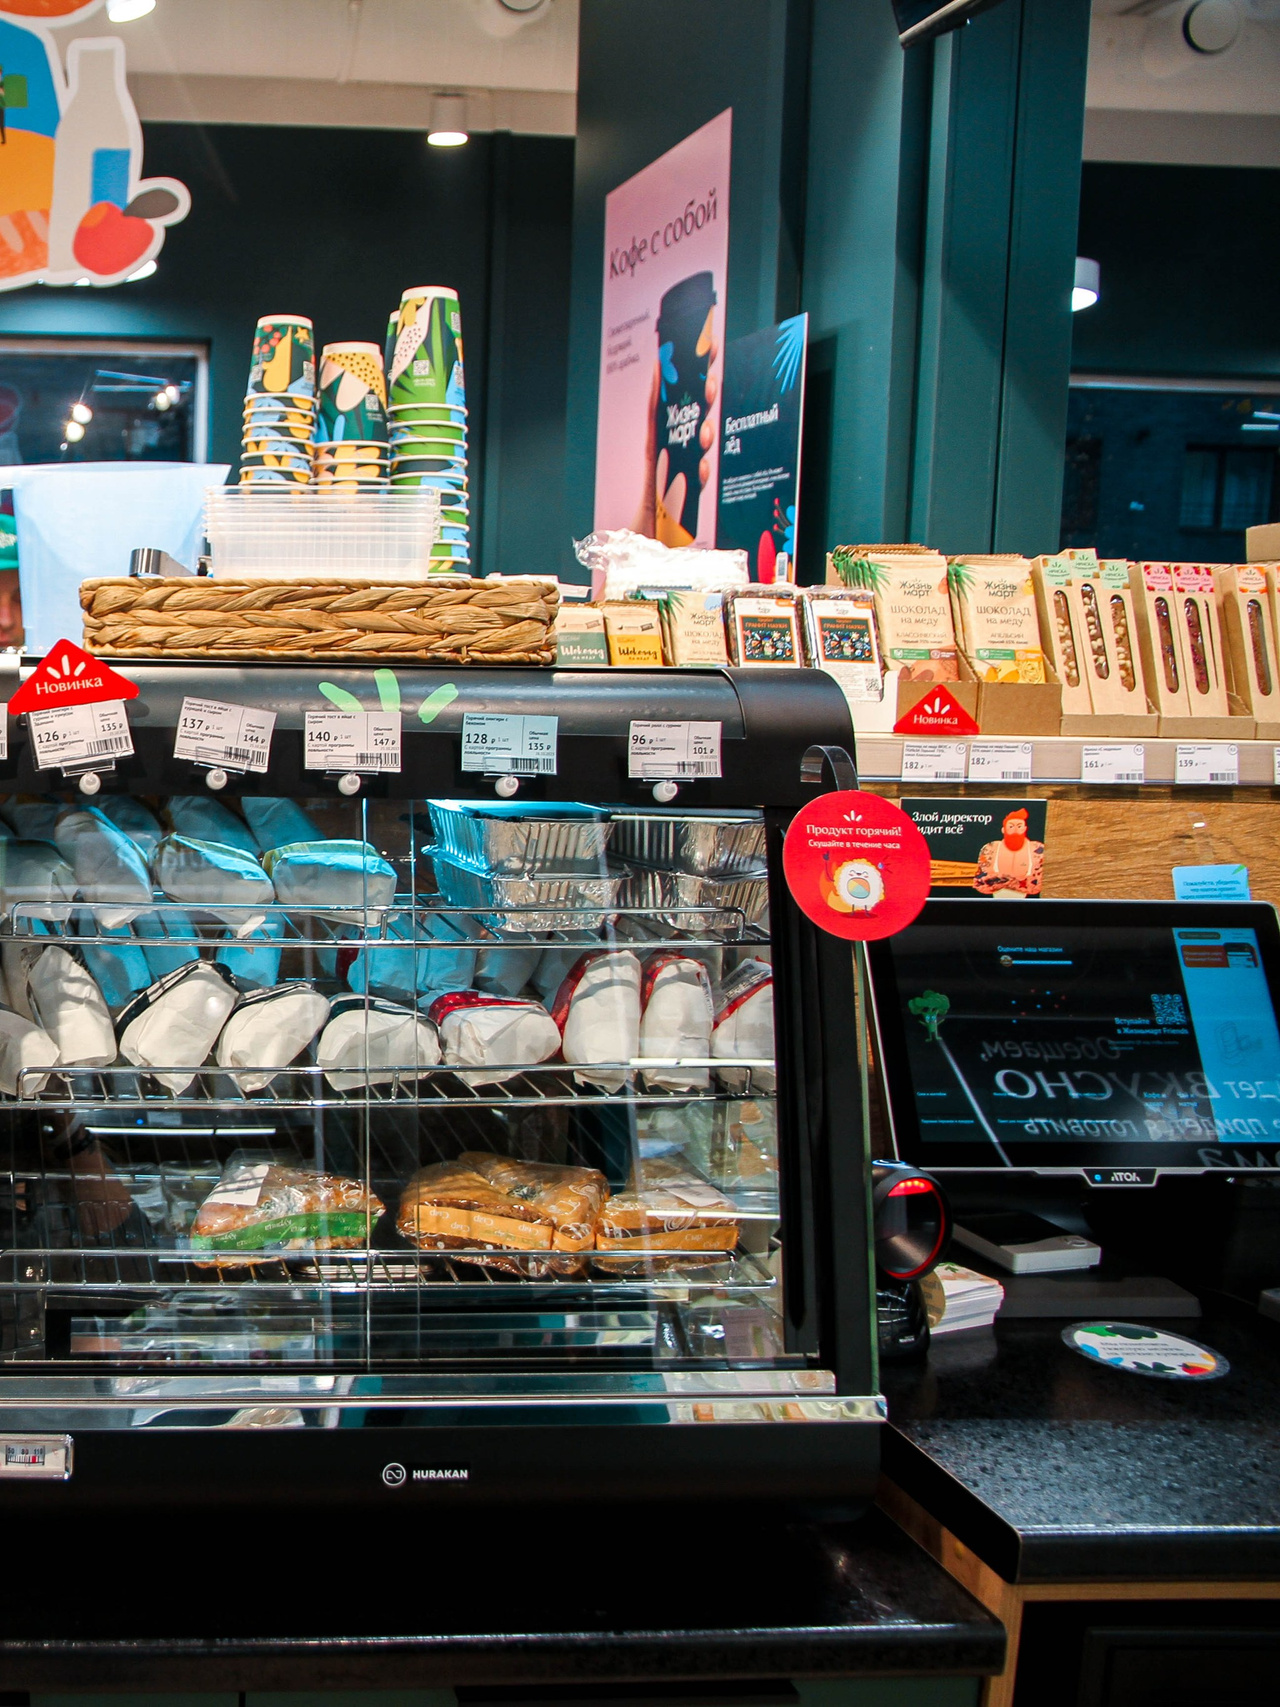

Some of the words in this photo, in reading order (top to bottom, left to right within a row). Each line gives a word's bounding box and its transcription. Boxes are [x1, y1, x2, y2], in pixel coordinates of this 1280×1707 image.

[610, 236, 648, 279] Кофе
[650, 230, 660, 254] с
[663, 187, 717, 247] собой
[666, 401, 701, 429] Жизнь
[724, 403, 779, 436] Бесплатный
[668, 420, 698, 448] март
[723, 435, 741, 456] лёд
[899, 580, 932, 590] Жизнь
[984, 580, 1017, 591] Жизнь
[903, 589, 931, 598] март
[988, 589, 1016, 599] март
[890, 605, 946, 615] ШОКОЛАД
[976, 605, 1031, 616] ШОКОЛАД
[915, 617, 939, 626] меду
[1000, 618, 1024, 627] меду
[35, 677, 104, 695] Новинка
[182, 717, 204, 730] 137
[913, 714, 958, 726] Новинка
[101, 722, 117, 732] 135
[36, 730, 59, 744] 126
[243, 734, 259, 743] 144
[308, 731, 331, 741] 140
[465, 733, 488, 744] 128
[631, 734, 646, 745] 96
[373, 738, 390, 746] 147
[528, 742, 544, 751] 135
[693, 747, 707, 755] 101
[904, 761, 919, 769] 182
[971, 757, 986, 765] 182
[1084, 760, 1099, 768] 161
[1178, 759, 1194, 767] 139
[912, 811, 939, 823] Злой
[940, 813, 992, 826] директор
[806, 824, 853, 836] Продукт
[856, 826, 902, 838] горячий!
[916, 826, 943, 835] идит
[945, 825, 963, 835] всё
[808, 839, 844, 850] Скушайте
[851, 841, 882, 849] течение
[412, 1469, 469, 1479] HURAKAN
